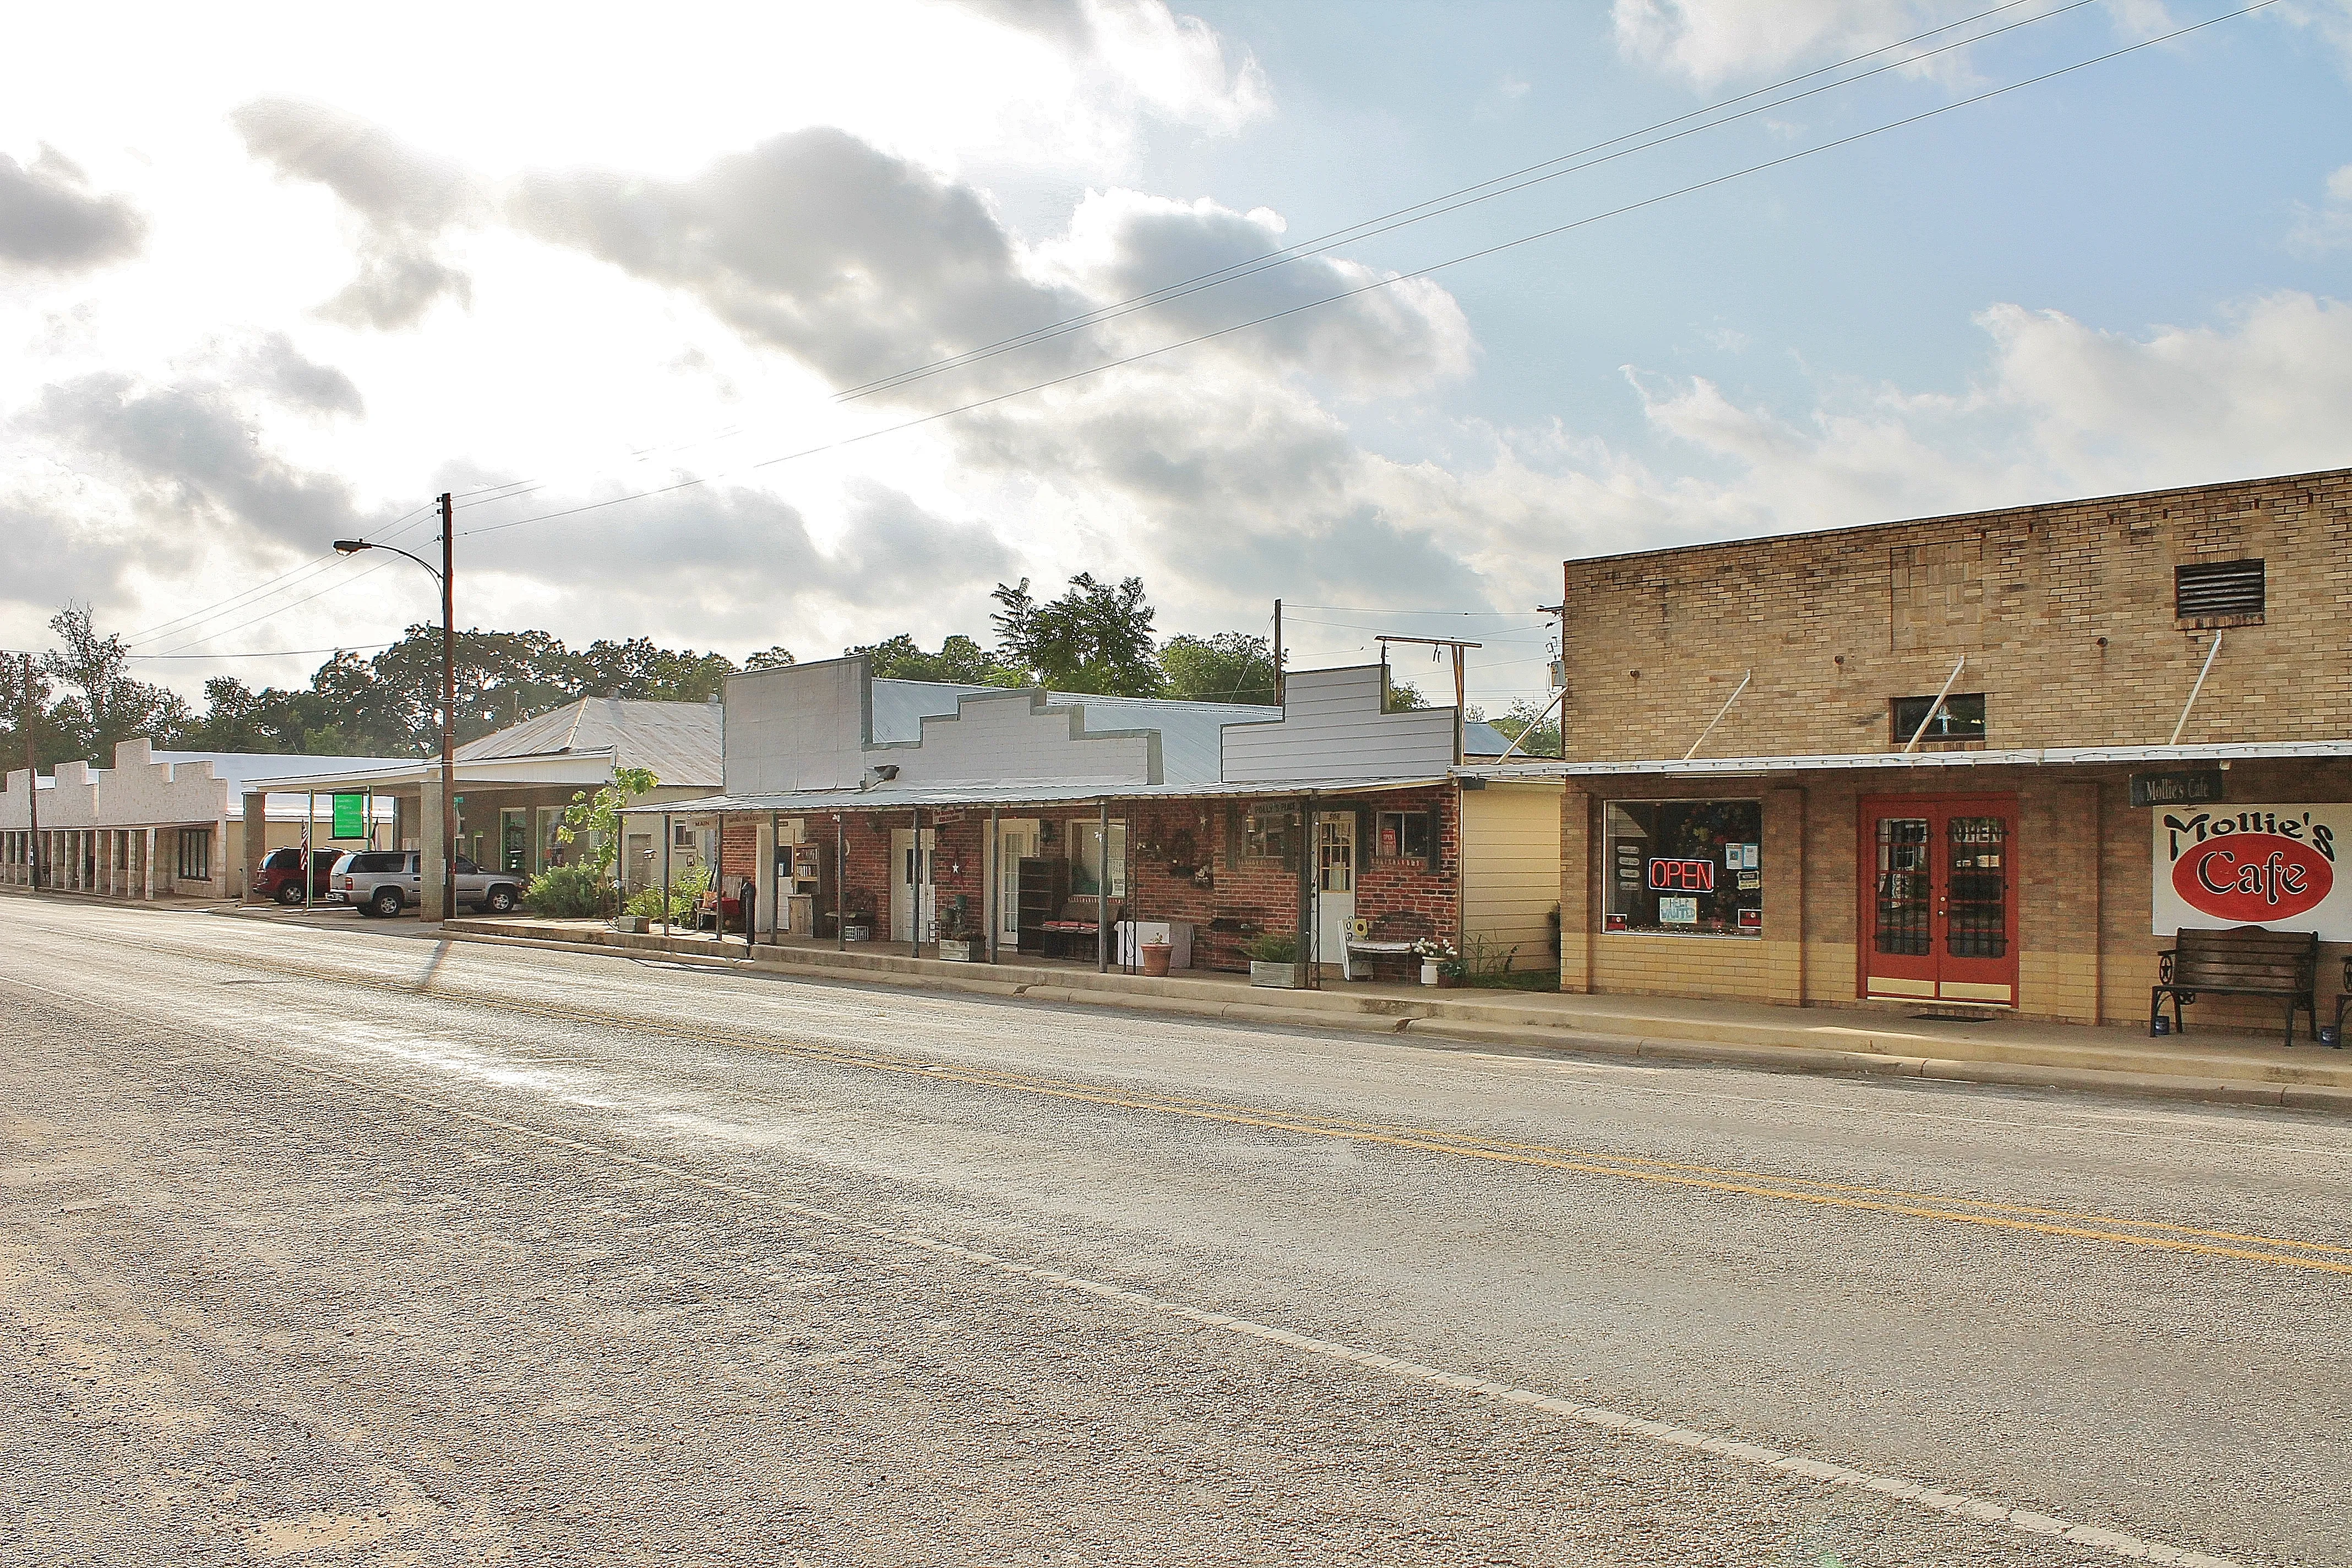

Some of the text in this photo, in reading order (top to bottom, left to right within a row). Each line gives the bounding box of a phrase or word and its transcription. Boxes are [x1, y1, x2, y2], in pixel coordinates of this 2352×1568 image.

[2147, 778, 2185, 801] Mollie's
[2163, 812, 2335, 862] Mollie's
[1651, 860, 1713, 890] OPEN
[2196, 851, 2307, 905] Cafe
[1660, 907, 1696, 919] WANTED
[1669, 898, 1689, 908] HELP
